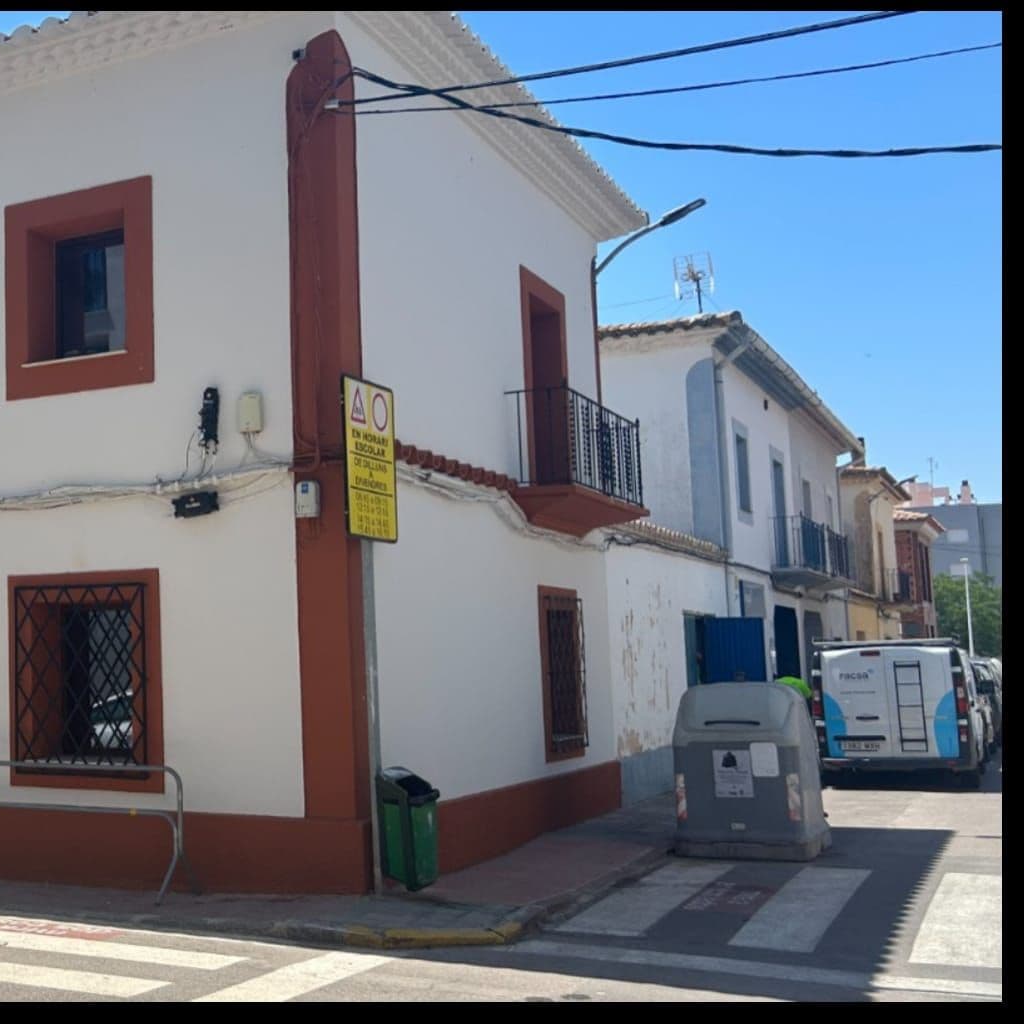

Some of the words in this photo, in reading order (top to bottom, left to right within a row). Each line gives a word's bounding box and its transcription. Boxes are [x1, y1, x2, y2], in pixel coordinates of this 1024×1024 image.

[351, 428, 361, 440] EN
[363, 431, 388, 447] HORARI
[355, 440, 386, 458] ESCOLAR
